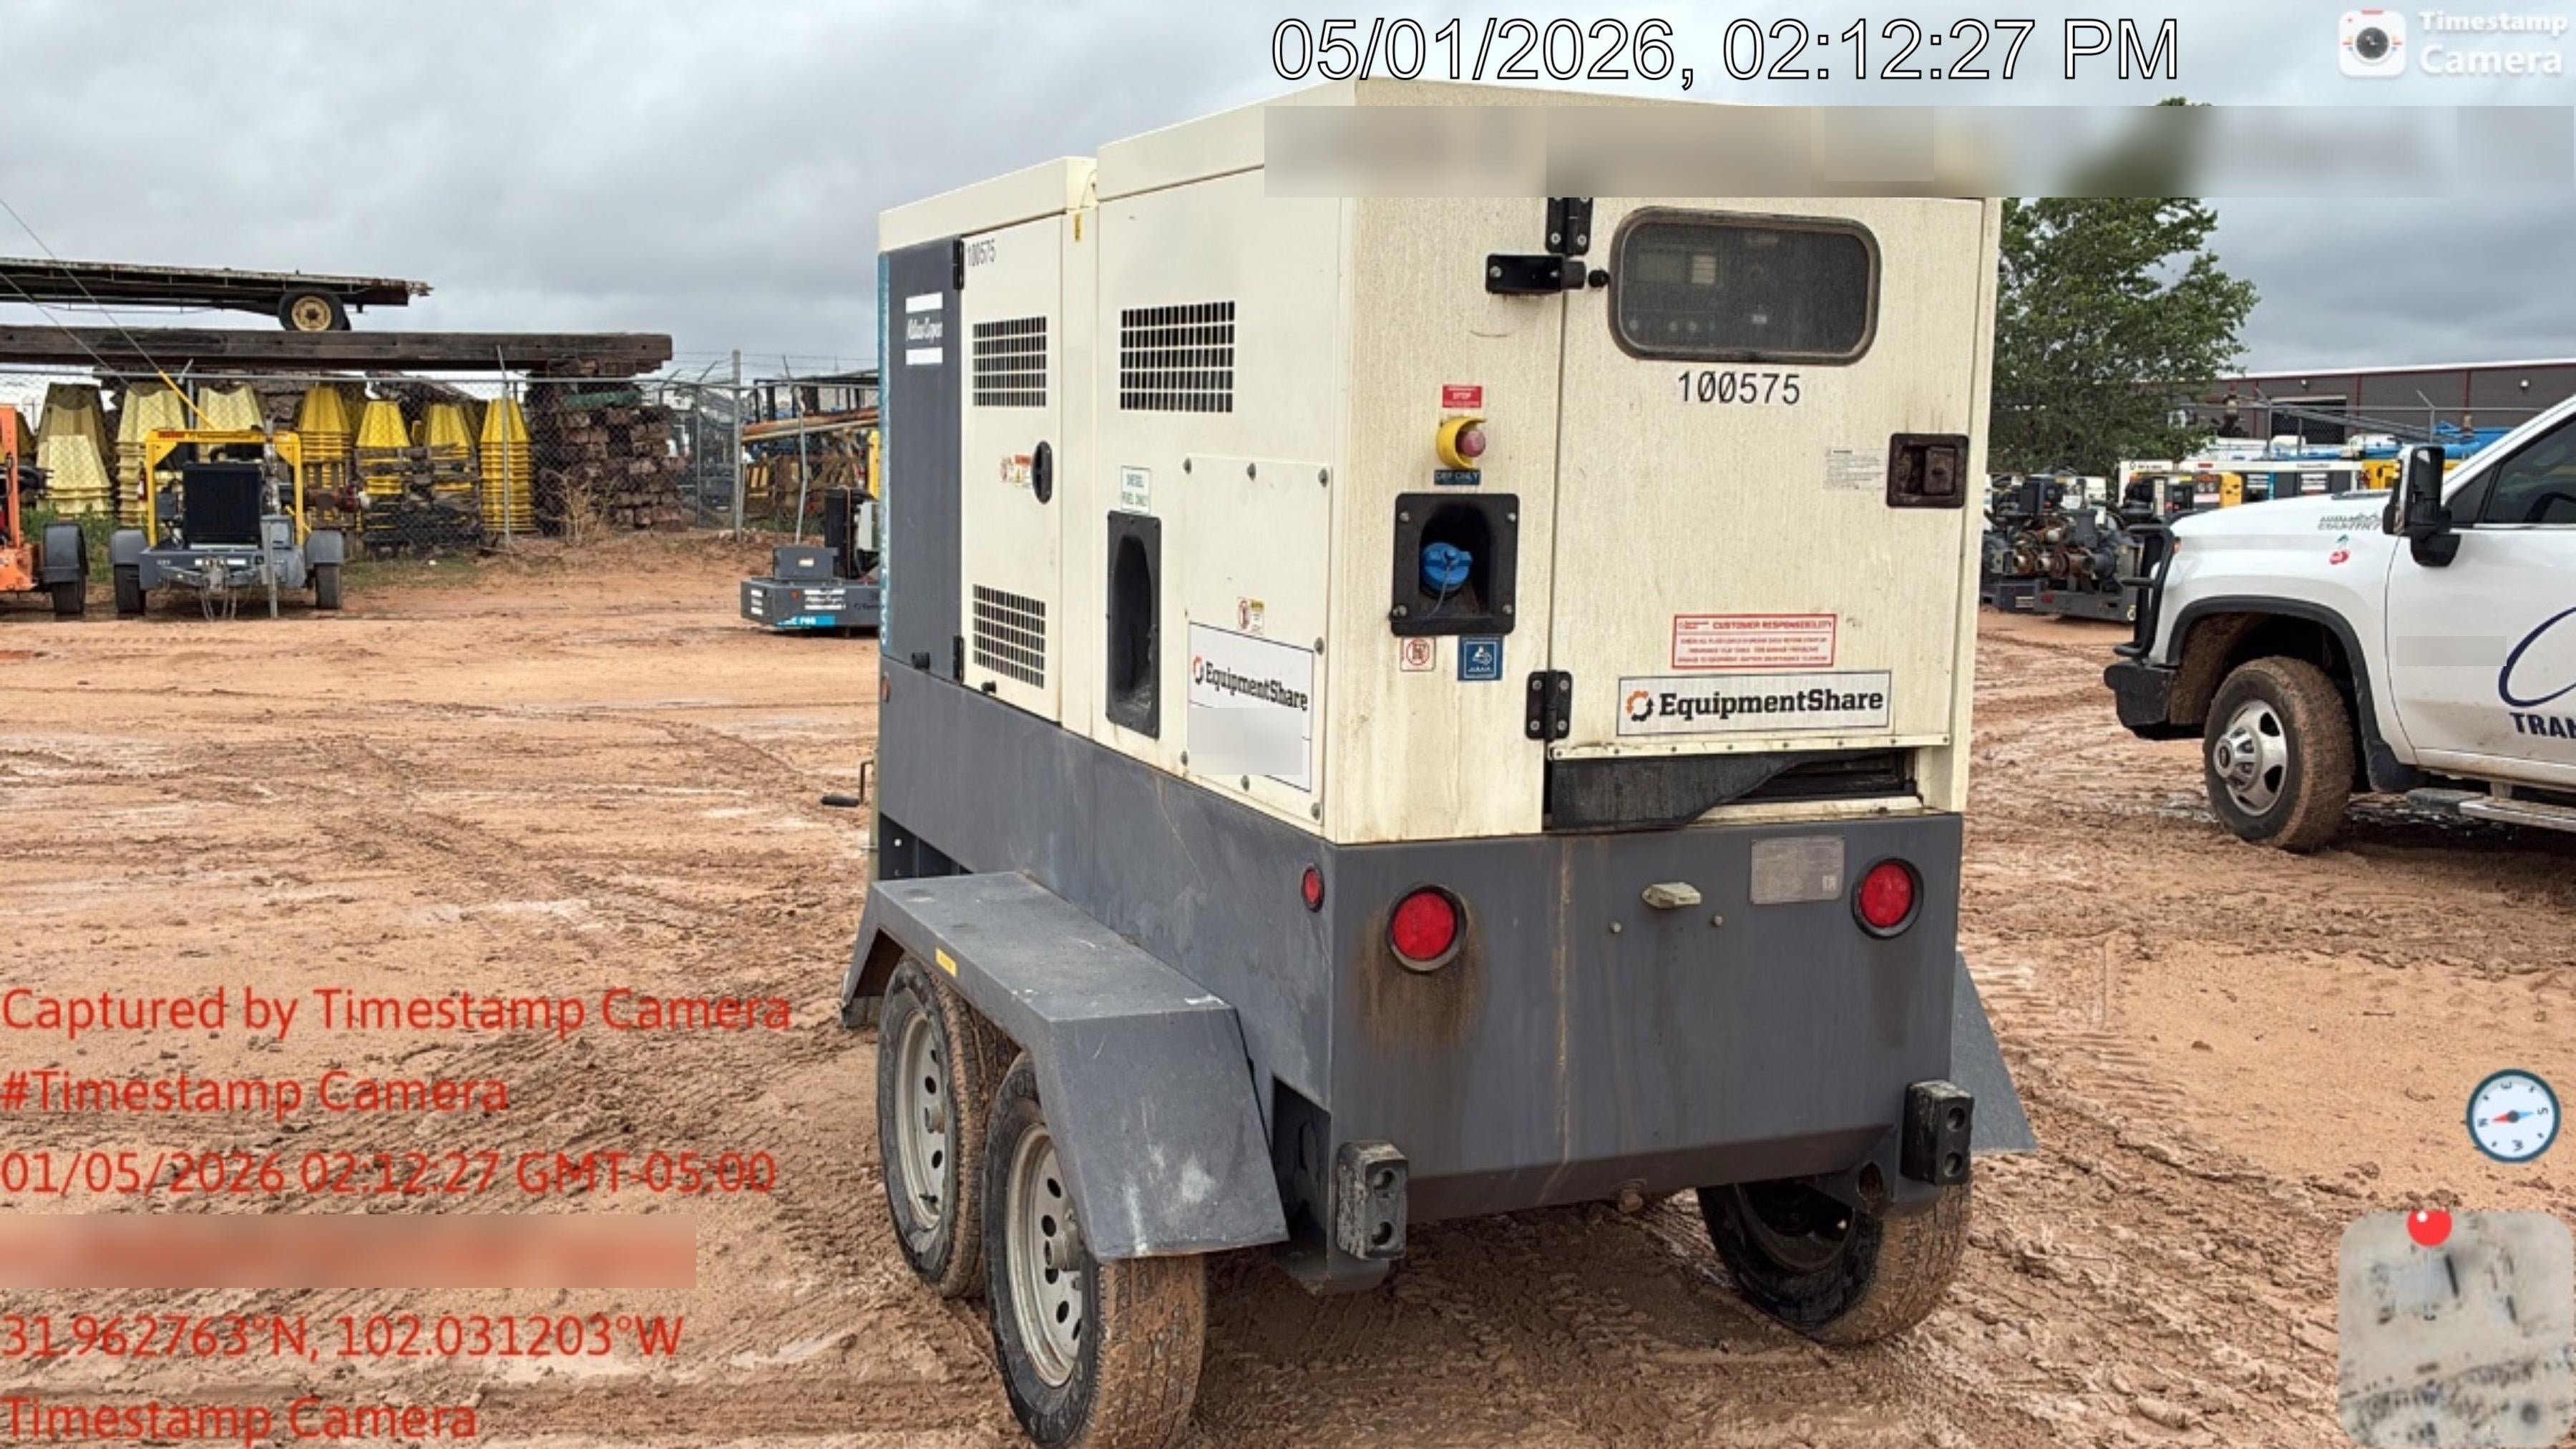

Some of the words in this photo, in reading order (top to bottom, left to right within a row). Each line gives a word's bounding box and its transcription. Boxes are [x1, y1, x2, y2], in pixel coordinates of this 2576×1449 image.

[1678, 370, 1800, 406] 100575
[1205, 660, 1309, 711] EquipmentShare
[1659, 688, 1883, 721] EquipmentShare
